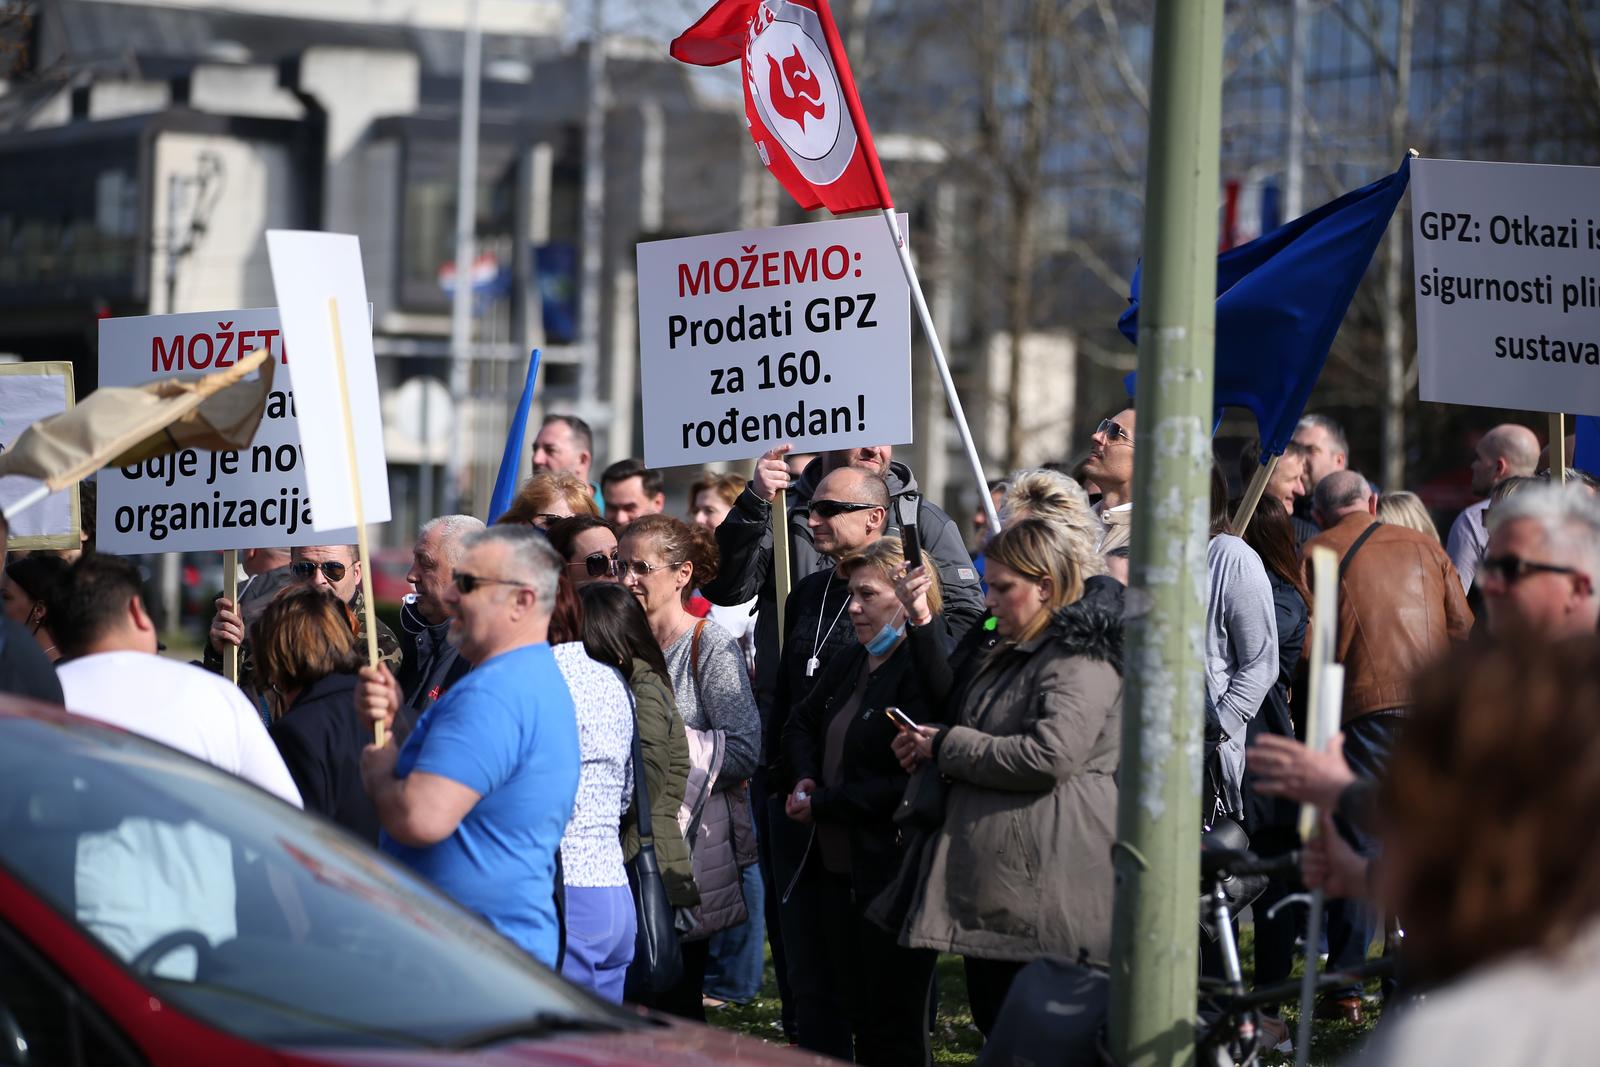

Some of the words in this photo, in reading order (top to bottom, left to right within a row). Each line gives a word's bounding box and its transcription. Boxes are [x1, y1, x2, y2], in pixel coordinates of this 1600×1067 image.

[1420, 211, 1481, 243] GPZ:
[1489, 215, 1578, 249] Otkazi
[677, 244, 862, 298] MOŽEMO:
[1420, 267, 1553, 305] sigurnosti
[668, 304, 792, 350] Prodati
[804, 293, 878, 334] GPZ
[710, 366, 746, 396] za
[757, 349, 832, 390] 160.
[682, 394, 866, 450] rođendan!
